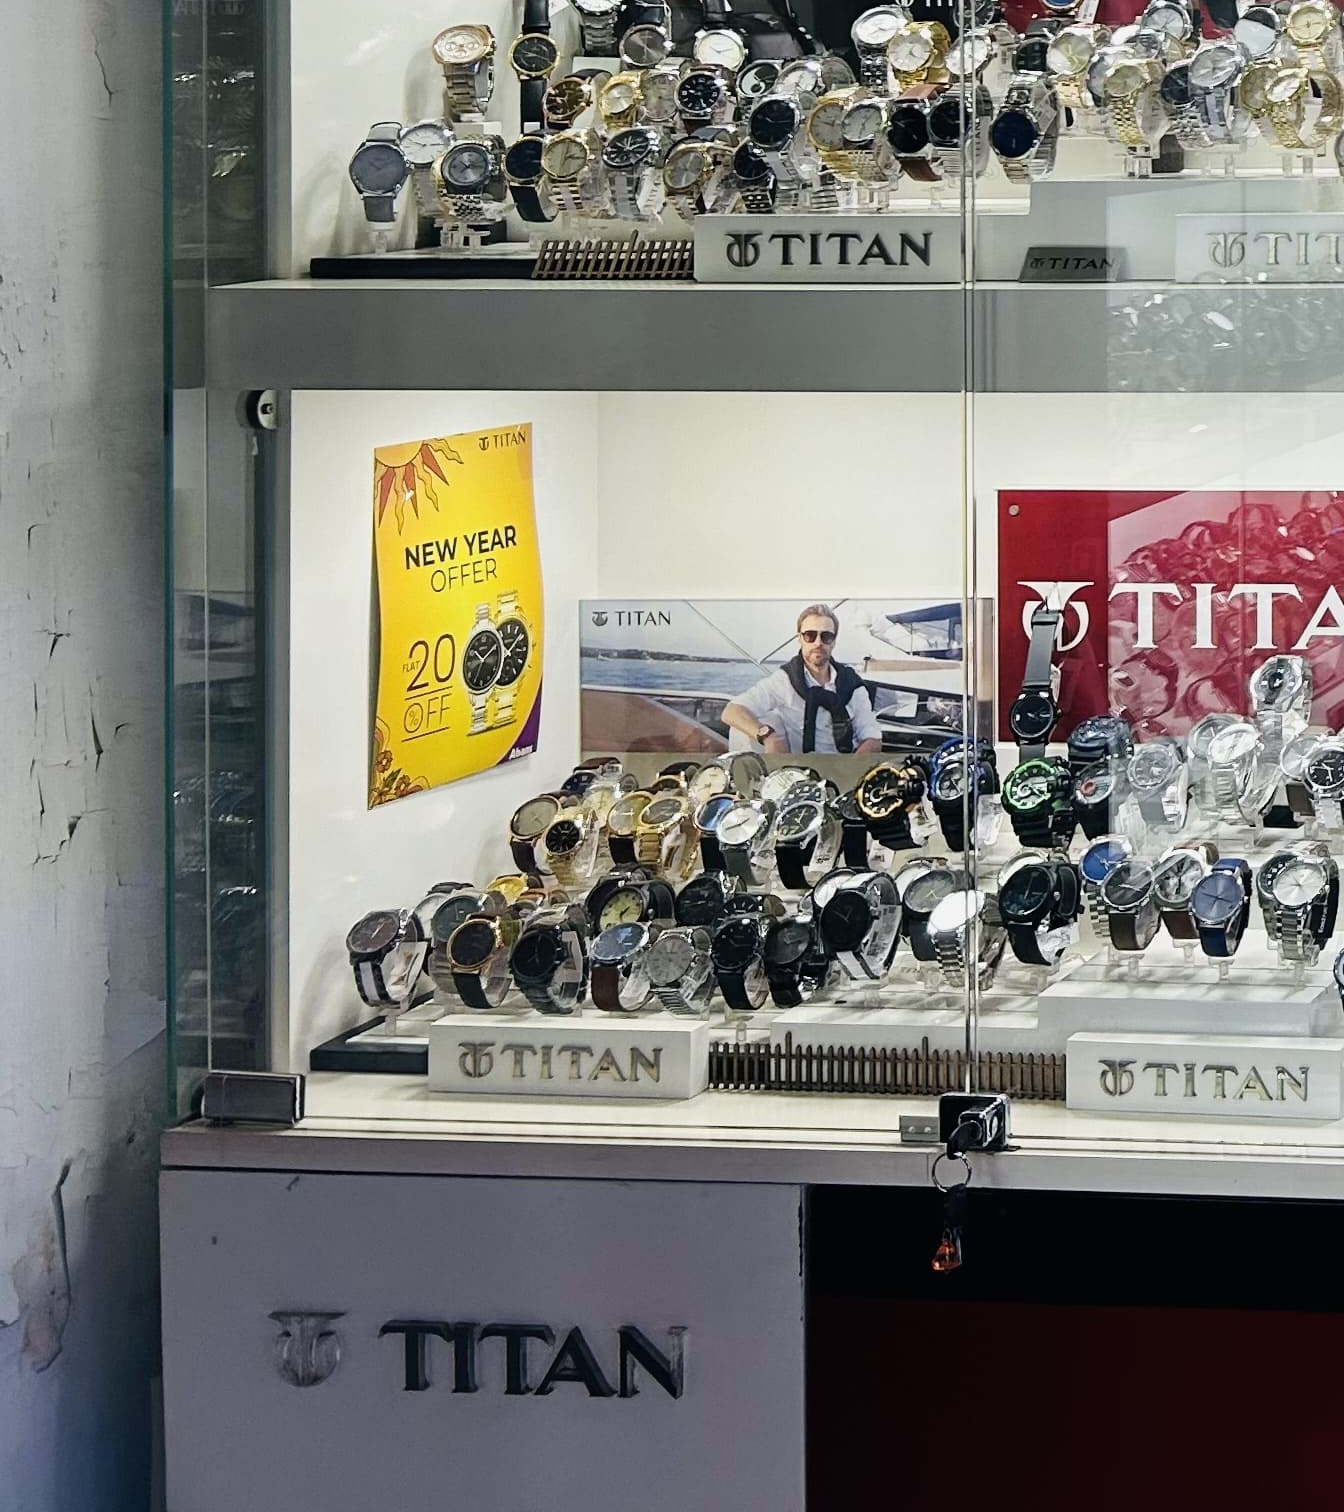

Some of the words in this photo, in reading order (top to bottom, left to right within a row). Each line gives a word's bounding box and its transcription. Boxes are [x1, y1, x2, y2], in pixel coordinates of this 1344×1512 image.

[768, 231, 933, 269] TITAN
[1043, 257, 1115, 272] TITAN
[493, 431, 527, 449] TITAN
[405, 538, 457, 570] NEW
[464, 524, 517, 556] YEAR
[431, 558, 498, 593] OFFER
[615, 610, 672, 627] TITAN
[407, 634, 456, 692] 20
[404, 695, 450, 734] OFF
[501, 1044, 663, 1083] TITAN
[1143, 1061, 1310, 1102] TITAN
[378, 1319, 688, 1400] TITAN
